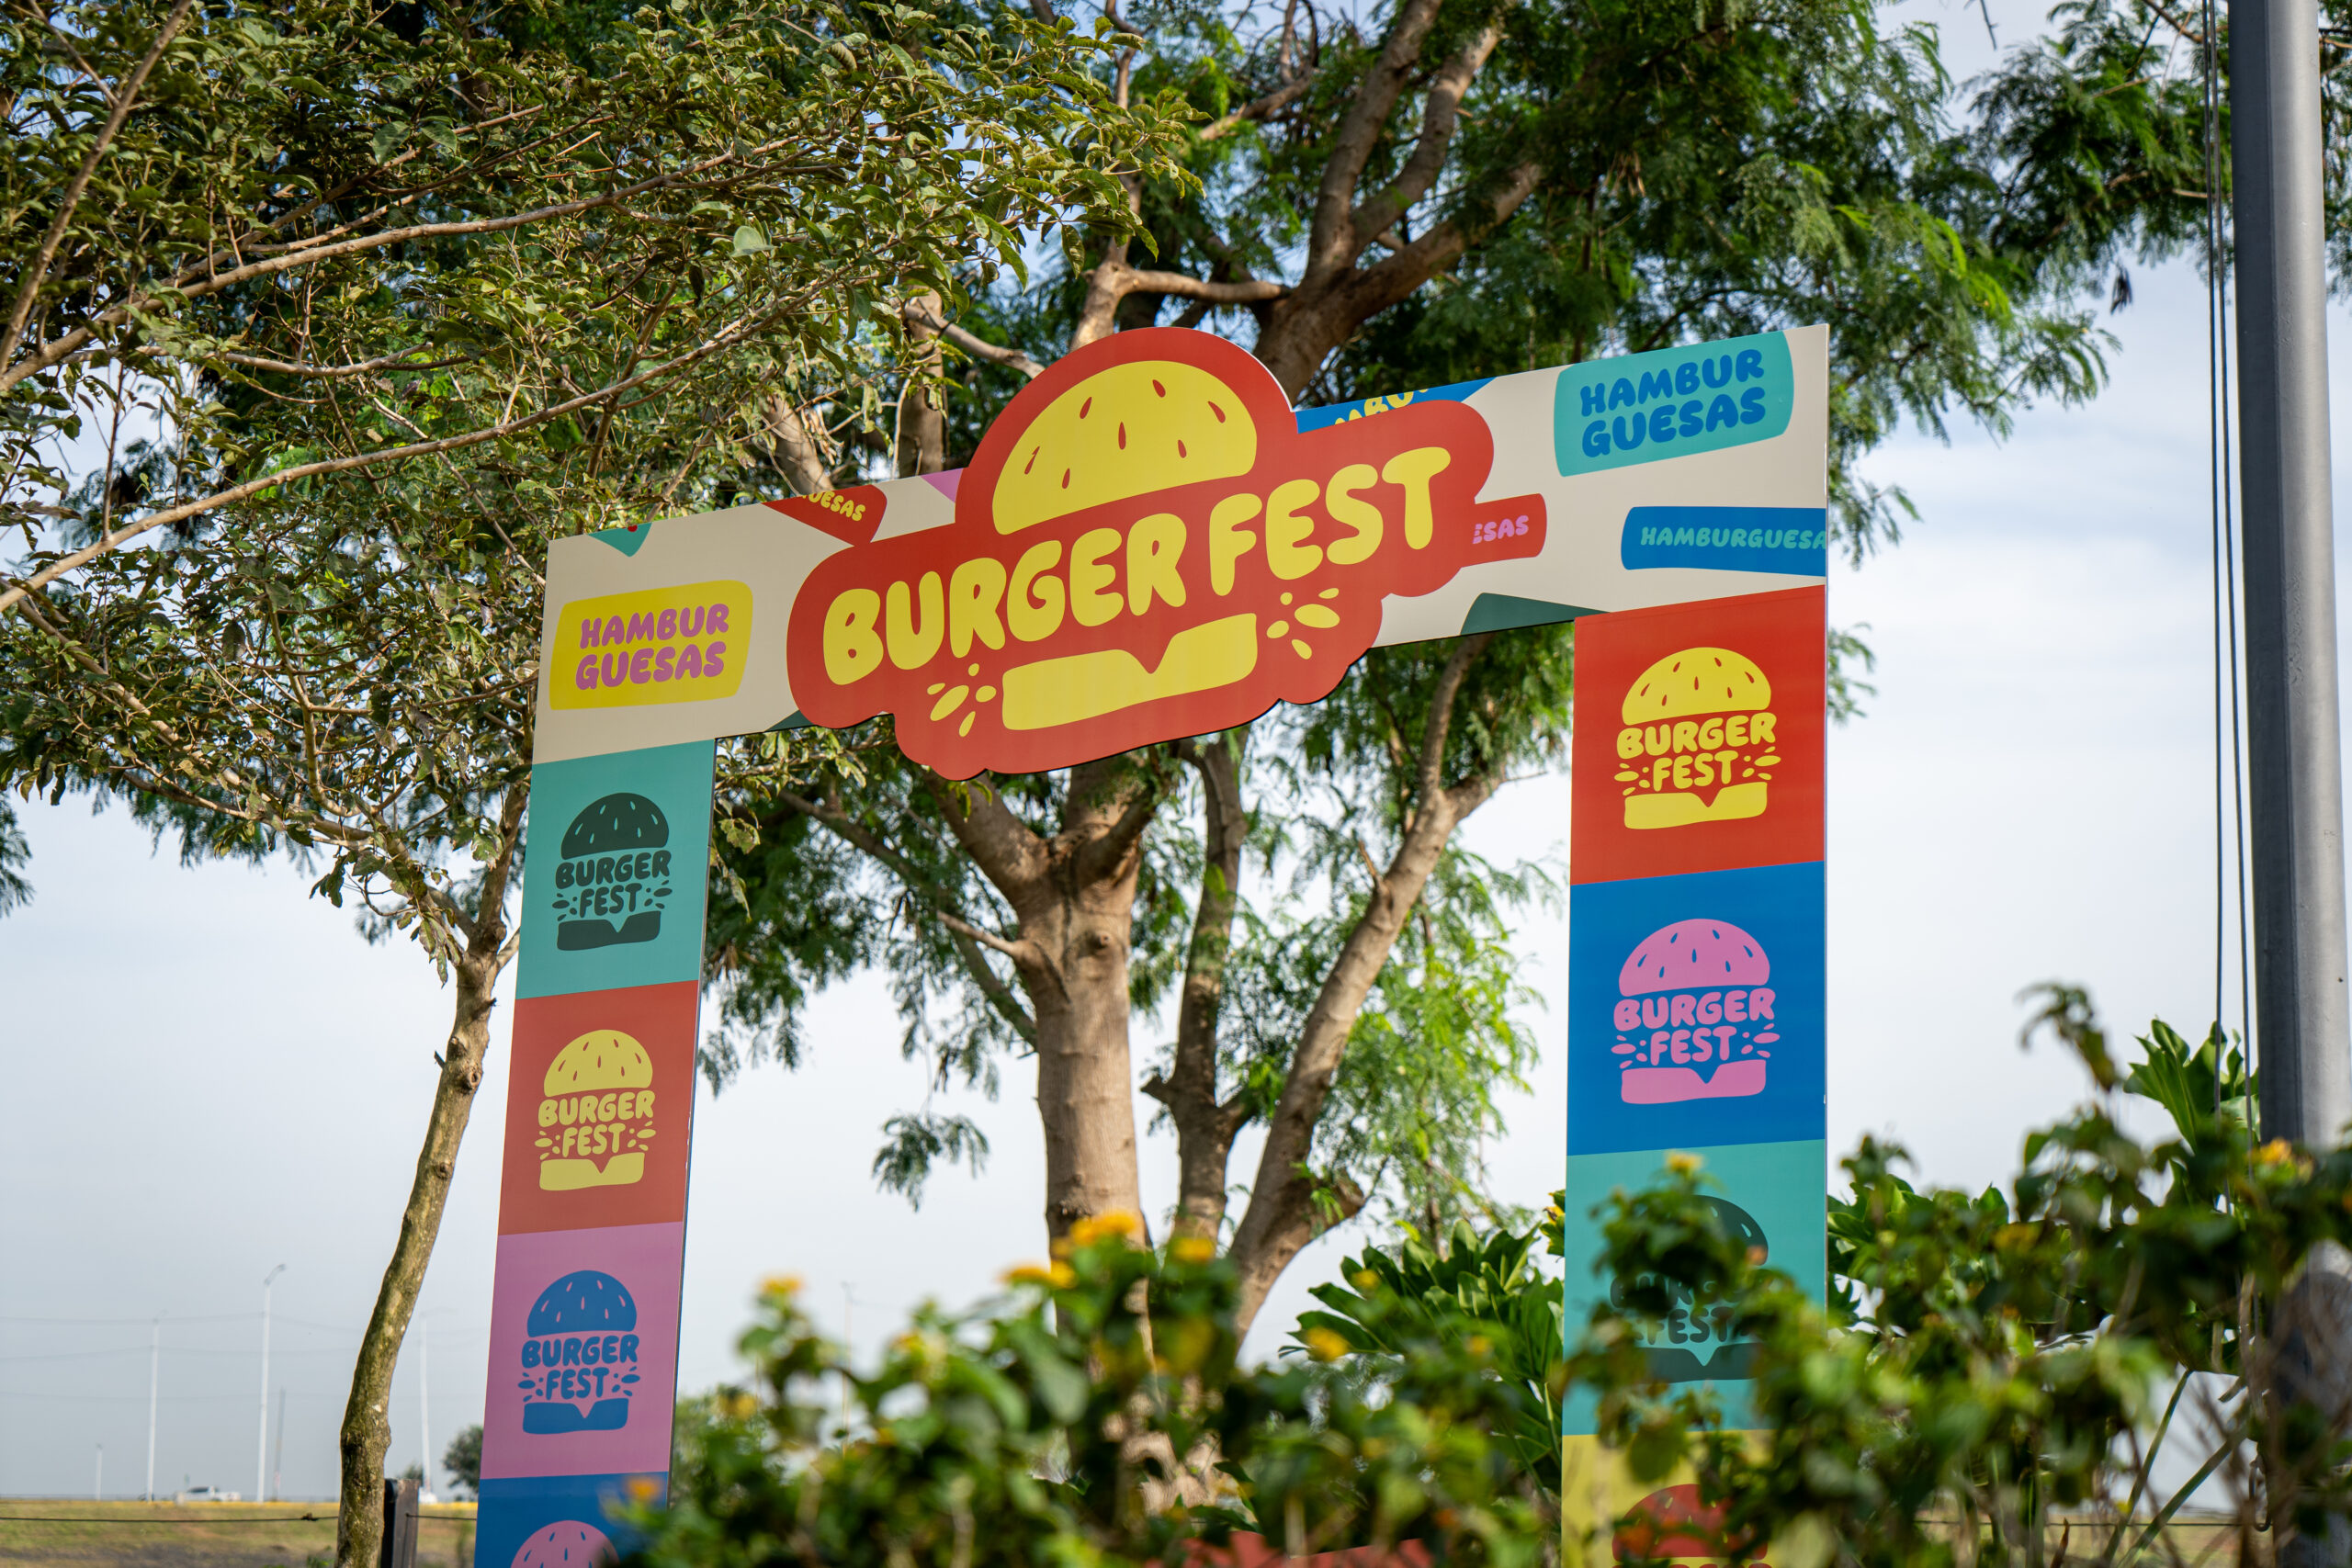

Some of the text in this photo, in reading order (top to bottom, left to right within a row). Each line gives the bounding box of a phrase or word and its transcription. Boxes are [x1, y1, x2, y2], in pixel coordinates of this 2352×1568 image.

[1580, 348, 1765, 416] HAMBUR
[1582, 387, 1765, 457] GUESAS
[823, 447, 1451, 685] BURGER FEST
[580, 604, 729, 649] HAMBUR
[576, 641, 726, 690] GUESAS
[1616, 712, 1777, 759] BURGER
[1653, 750, 1738, 792] FEST
[556, 851, 672, 889] BURGER
[580, 883, 642, 918] FEST
[1613, 987, 1777, 1032] BURGER
[1650, 1026, 1736, 1066] FEST
[538, 1089, 656, 1127] BURGER
[562, 1122, 626, 1157] FEST
[521, 1334, 639, 1369] BURGER
[546, 1367, 609, 1400] FEST
